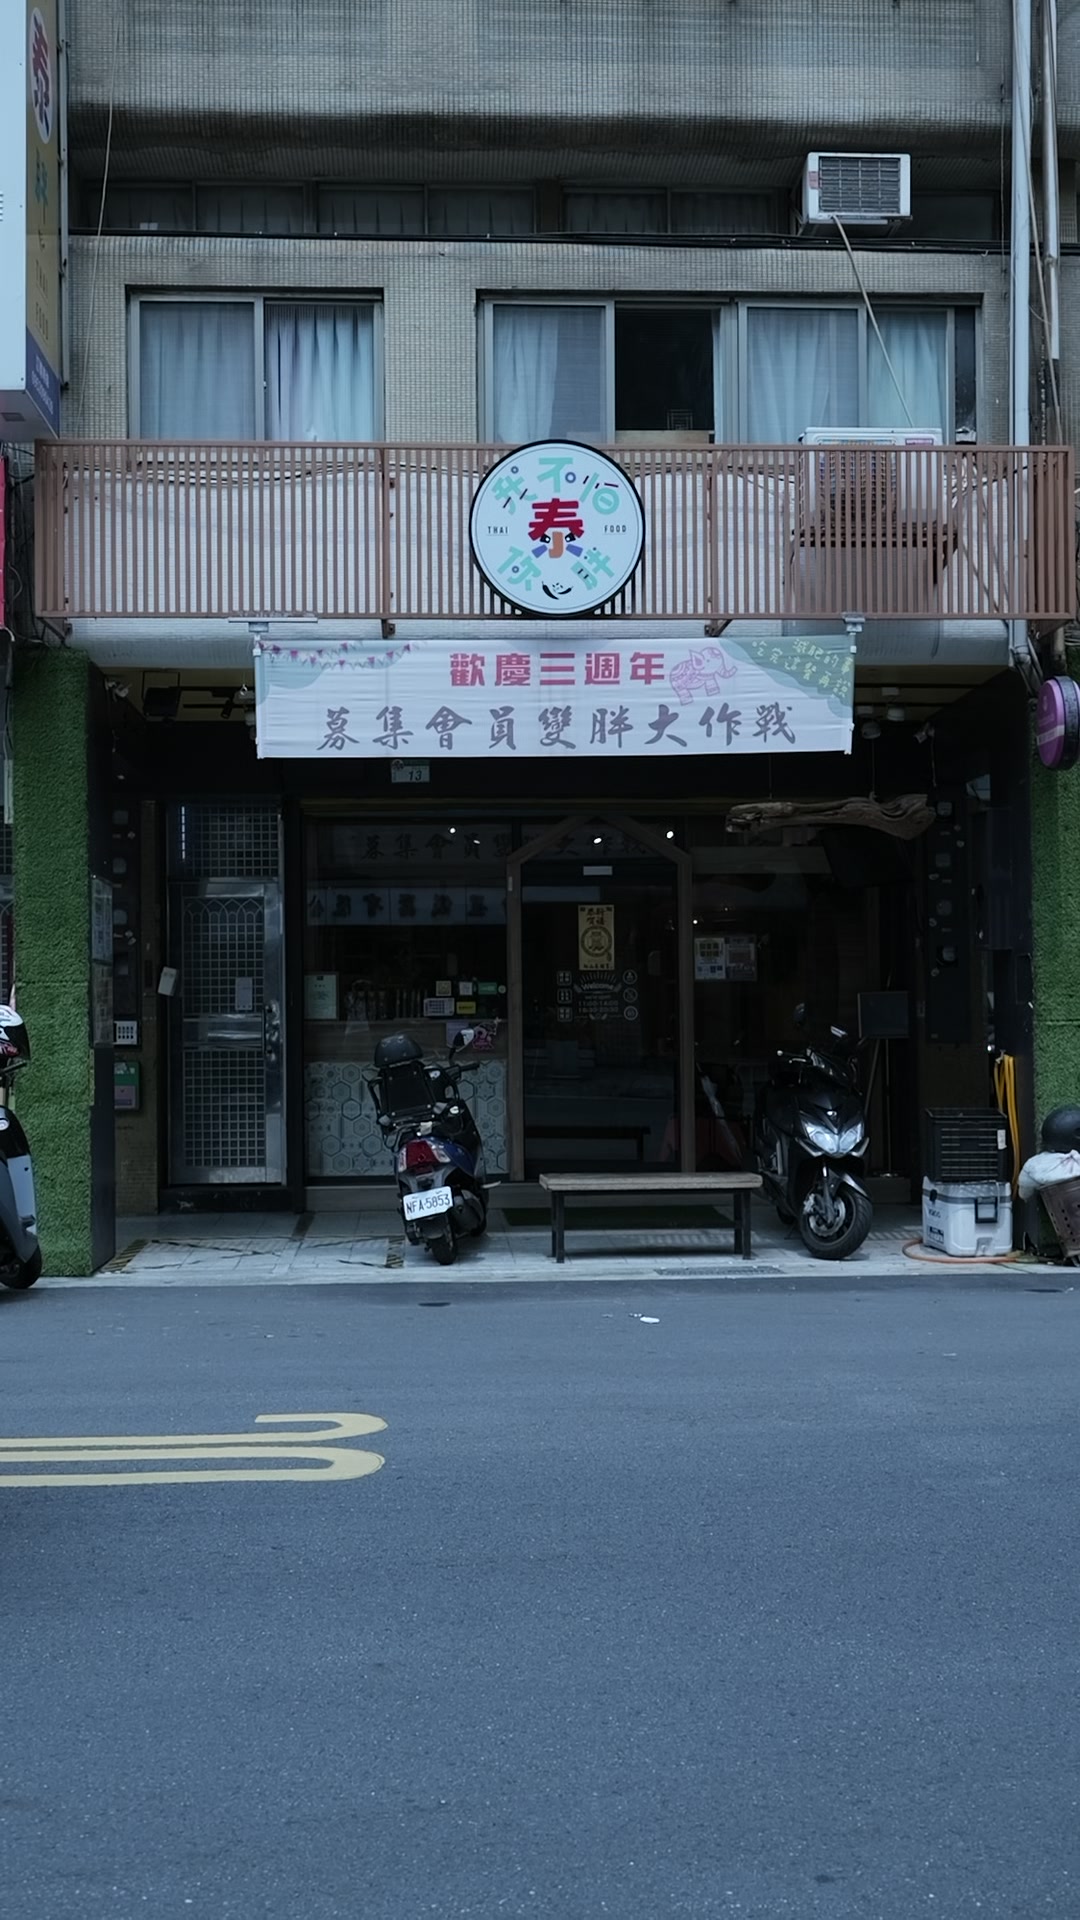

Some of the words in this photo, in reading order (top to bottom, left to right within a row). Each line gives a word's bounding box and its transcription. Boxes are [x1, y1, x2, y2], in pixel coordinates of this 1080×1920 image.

[488, 526, 509, 534] THAI
[604, 525, 627, 533] FOOD
[449, 652, 666, 687] 歡慶三週年
[316, 702, 796, 752] 募集會員變胖大作戰
[408, 770, 423, 781] 13
[406, 1194, 451, 1214] NFA-5853
